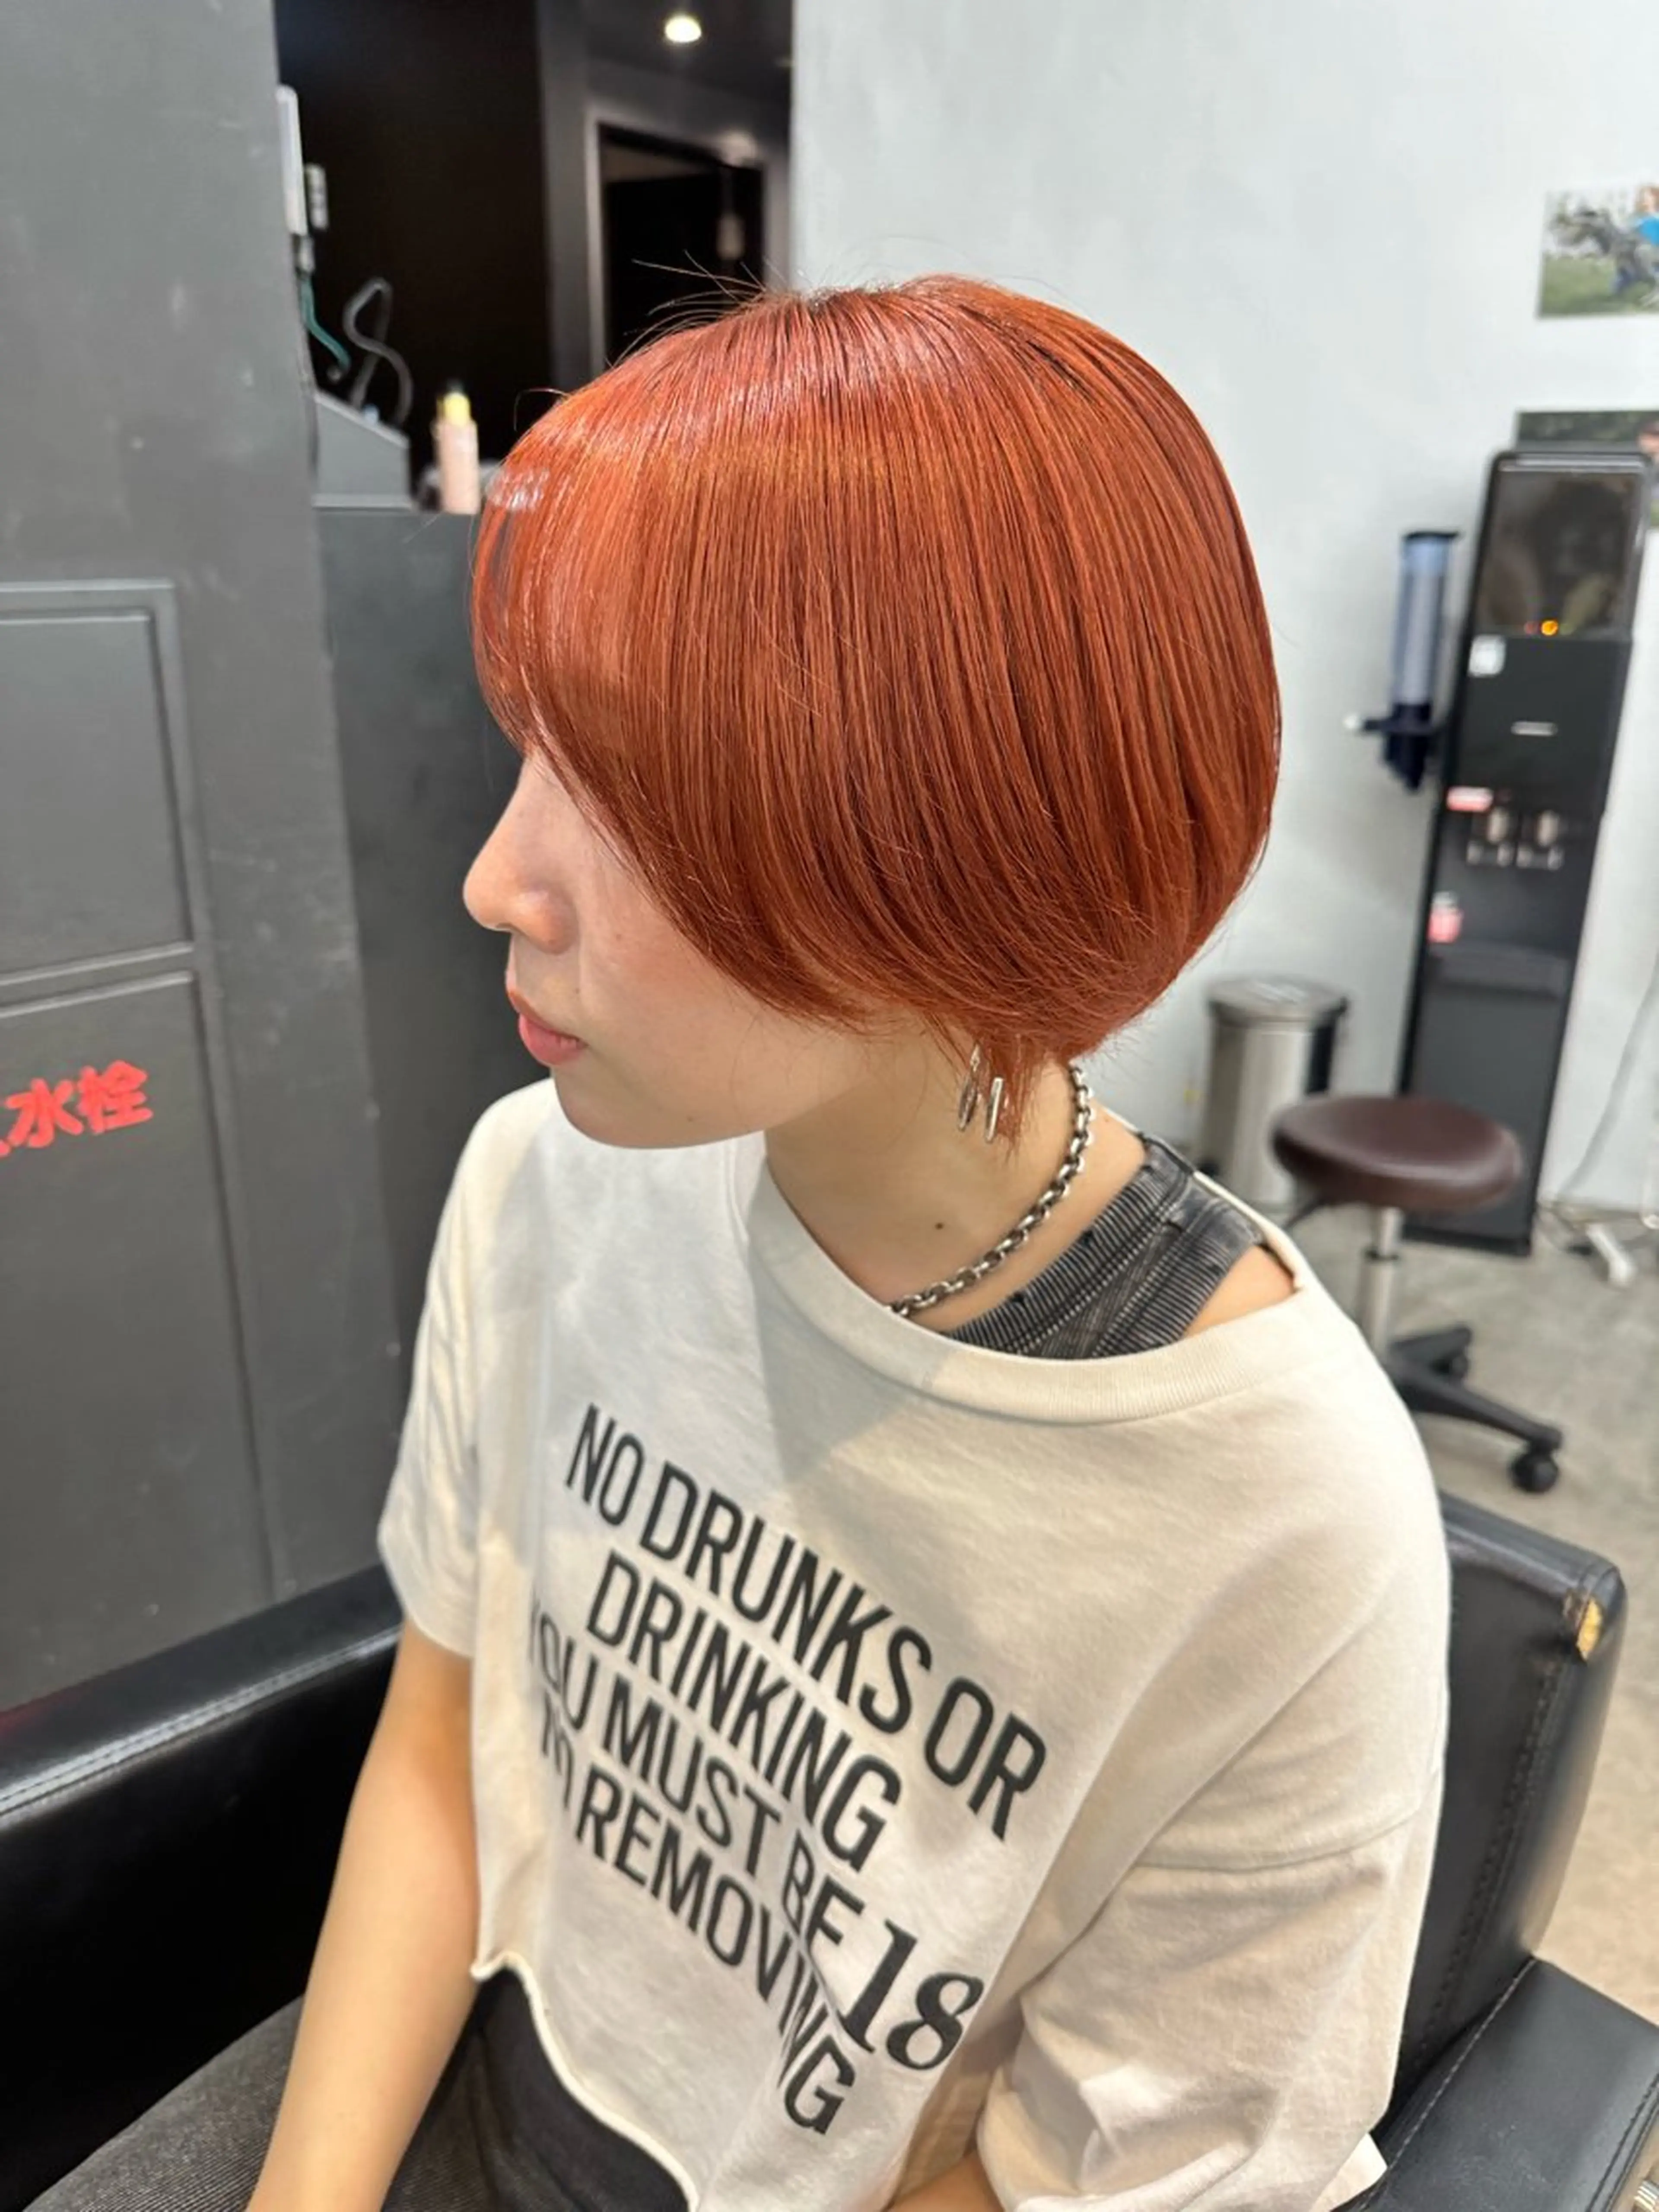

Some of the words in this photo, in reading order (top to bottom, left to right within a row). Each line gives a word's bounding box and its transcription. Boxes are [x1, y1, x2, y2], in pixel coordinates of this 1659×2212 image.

[0, 1059, 153, 1158] 水栓
[566, 1402, 645, 1526] NO
[640, 1459, 932, 1734] DRUNKS
[924, 1677, 1046, 1841] OR
[586, 1548, 901, 1872] DRINKING
[576, 1763, 856, 2135] REMOVING
[603, 1673, 781, 1878] MUST
[837, 1919, 984, 2070] 18
